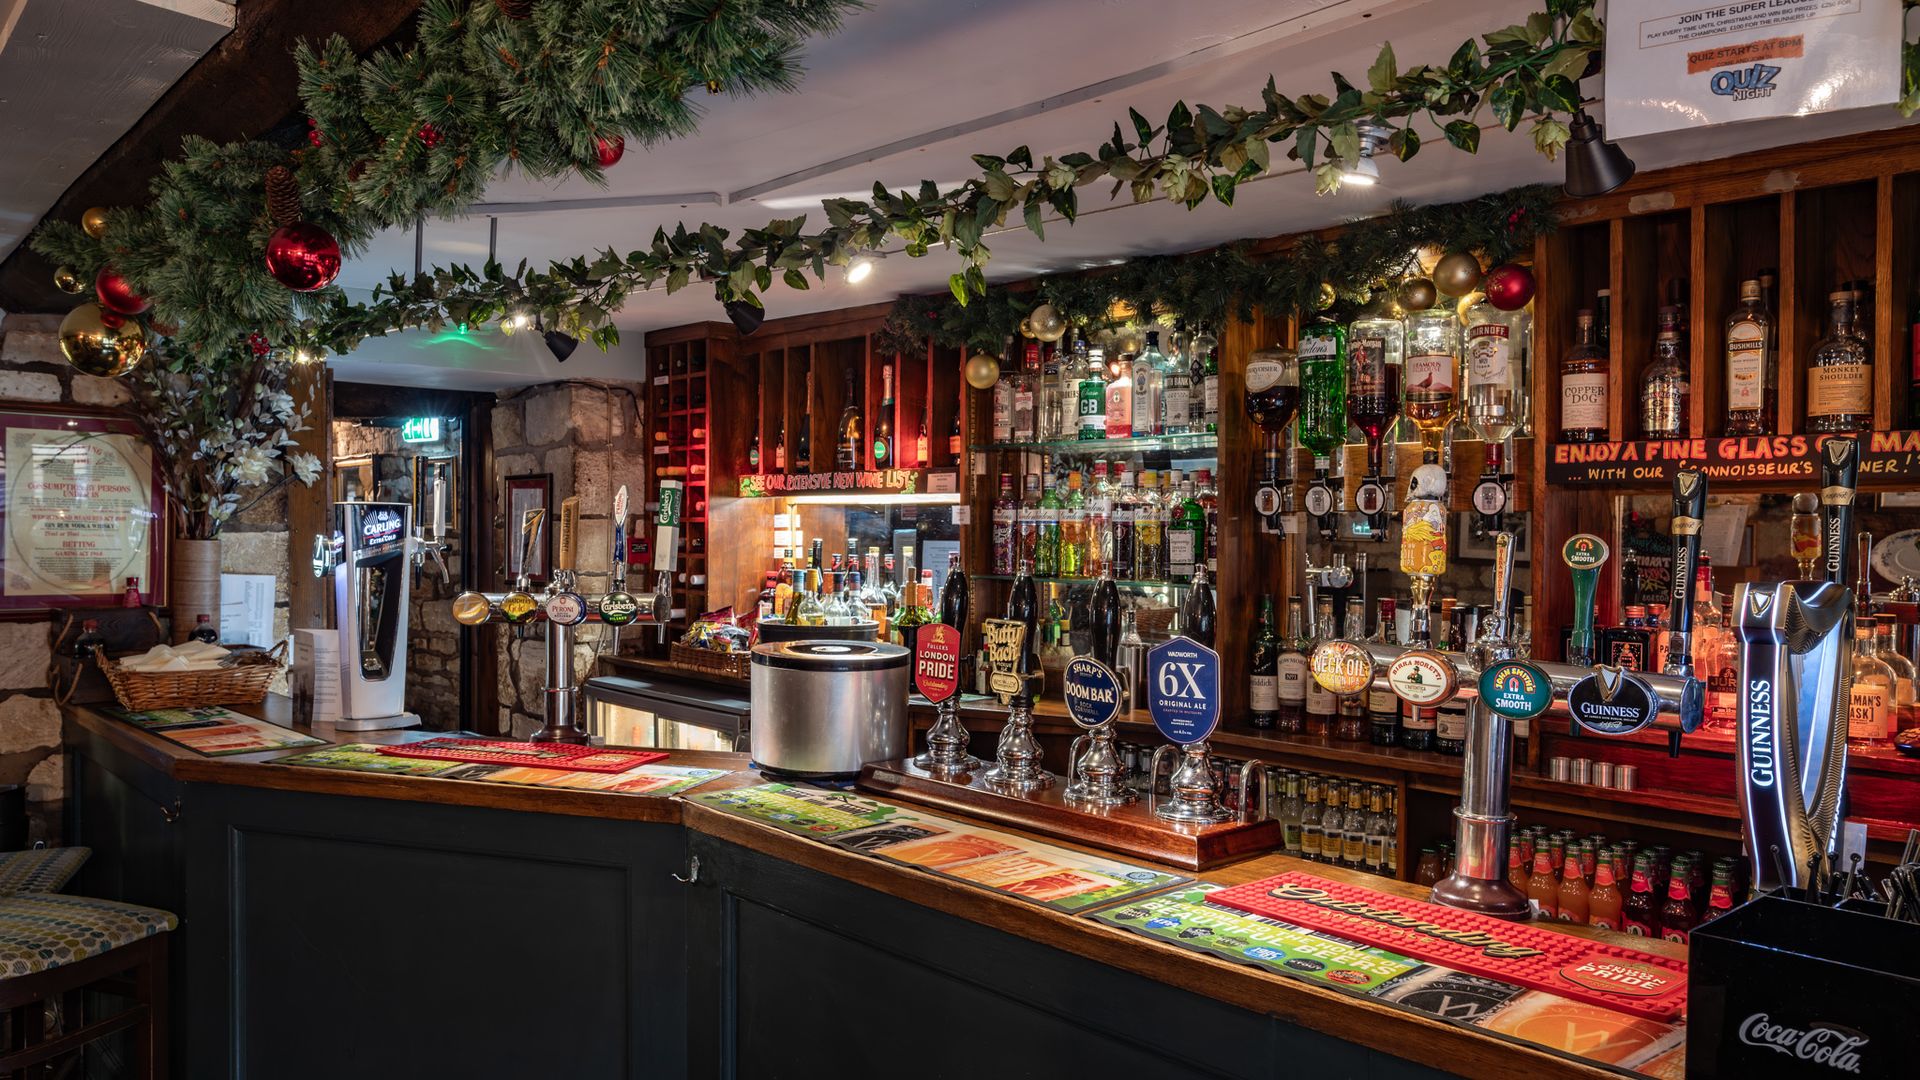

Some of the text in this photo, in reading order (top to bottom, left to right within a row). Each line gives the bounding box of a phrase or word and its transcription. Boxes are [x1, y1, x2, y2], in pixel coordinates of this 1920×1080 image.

[1678, 14, 1702, 25] JOIN
[1705, 9, 1726, 19] THE
[1729, 1, 1766, 15] SUPER
[1662, 29, 1682, 37] EVERY
[1683, 25, 1697, 33] TIME
[1698, 23, 1716, 31] UNTIL
[1716, 17, 1752, 27] CHRISTMAS
[1691, 27, 1727, 38] CHAMPIONS
[1744, 21, 1758, 29] FOR
[1689, 38, 1802, 64] QUIZ STARTS AT 8PM
[1711, 64, 1781, 95] QUIZ
[1733, 87, 1774, 101] NIGHT
[1299, 341, 1328, 356] rdon's
[1729, 341, 1763, 351] BUSHMILLS
[1819, 373, 1863, 381] SHOULDER
[1823, 366, 1860, 374] MONKEY
[1564, 386, 1605, 398] COPPER
[1572, 394, 1598, 404] DOG
[1081, 399, 1098, 414] GB
[1555, 442, 1622, 464] ENJOY
[1622, 442, 1639, 462] A
[1645, 439, 1707, 462] FINE
[1718, 436, 1809, 460] GLASS
[750, 475, 766, 492] SEE
[766, 474, 786, 490] OUR
[787, 472, 832, 491] EXTENSIVE
[833, 472, 855, 489] NEW
[856, 471, 883, 489] WINE
[886, 470, 911, 487] LIST
[1588, 468, 1627, 480] WITH
[1633, 466, 1664, 479] OUR
[364, 519, 402, 535] CARLING
[369, 534, 397, 546] EXTRA COLD
[1827, 517, 1841, 573] GUINNESS
[1571, 555, 1595, 563] SMOOTH
[1674, 546, 1688, 599] GUINNESS
[601, 600, 637, 614] Carlsberg
[986, 623, 1025, 646] Butty
[920, 650, 955, 662] LONDON
[988, 643, 1020, 661] Bach
[1167, 651, 1198, 659] WADWORTH
[919, 660, 954, 680] PRIDE
[1073, 663, 1103, 679] SHARP'S
[1314, 656, 1366, 677] NECK OIL
[1393, 660, 1442, 681] BIRRA MORETTI
[1159, 662, 1206, 699] 6X
[1496, 668, 1535, 693] JOHN SMITH'S
[1711, 678, 1737, 687] JUR
[1066, 681, 1115, 703] DOOM BAR
[1504, 693, 1525, 701] EXTRA
[1159, 699, 1192, 709] ORIGINAL
[1495, 699, 1532, 711] SMOOTH
[1581, 702, 1640, 718] GUINNESS
[1850, 706, 1874, 722] ASK]
[1751, 680, 1774, 787] GUINNESS
[1267, 884, 1546, 959] Outstanding
[1141, 901, 1399, 977] BEAUTIFUL BEERS
[1249, 922, 1272, 934] TO
[1274, 928, 1315, 945] THE
[1315, 939, 1374, 963] HOME
[1382, 958, 1412, 970] OF
[1575, 965, 1655, 990] PRIDE
[1739, 1012, 1870, 1074] Coca-Cola
